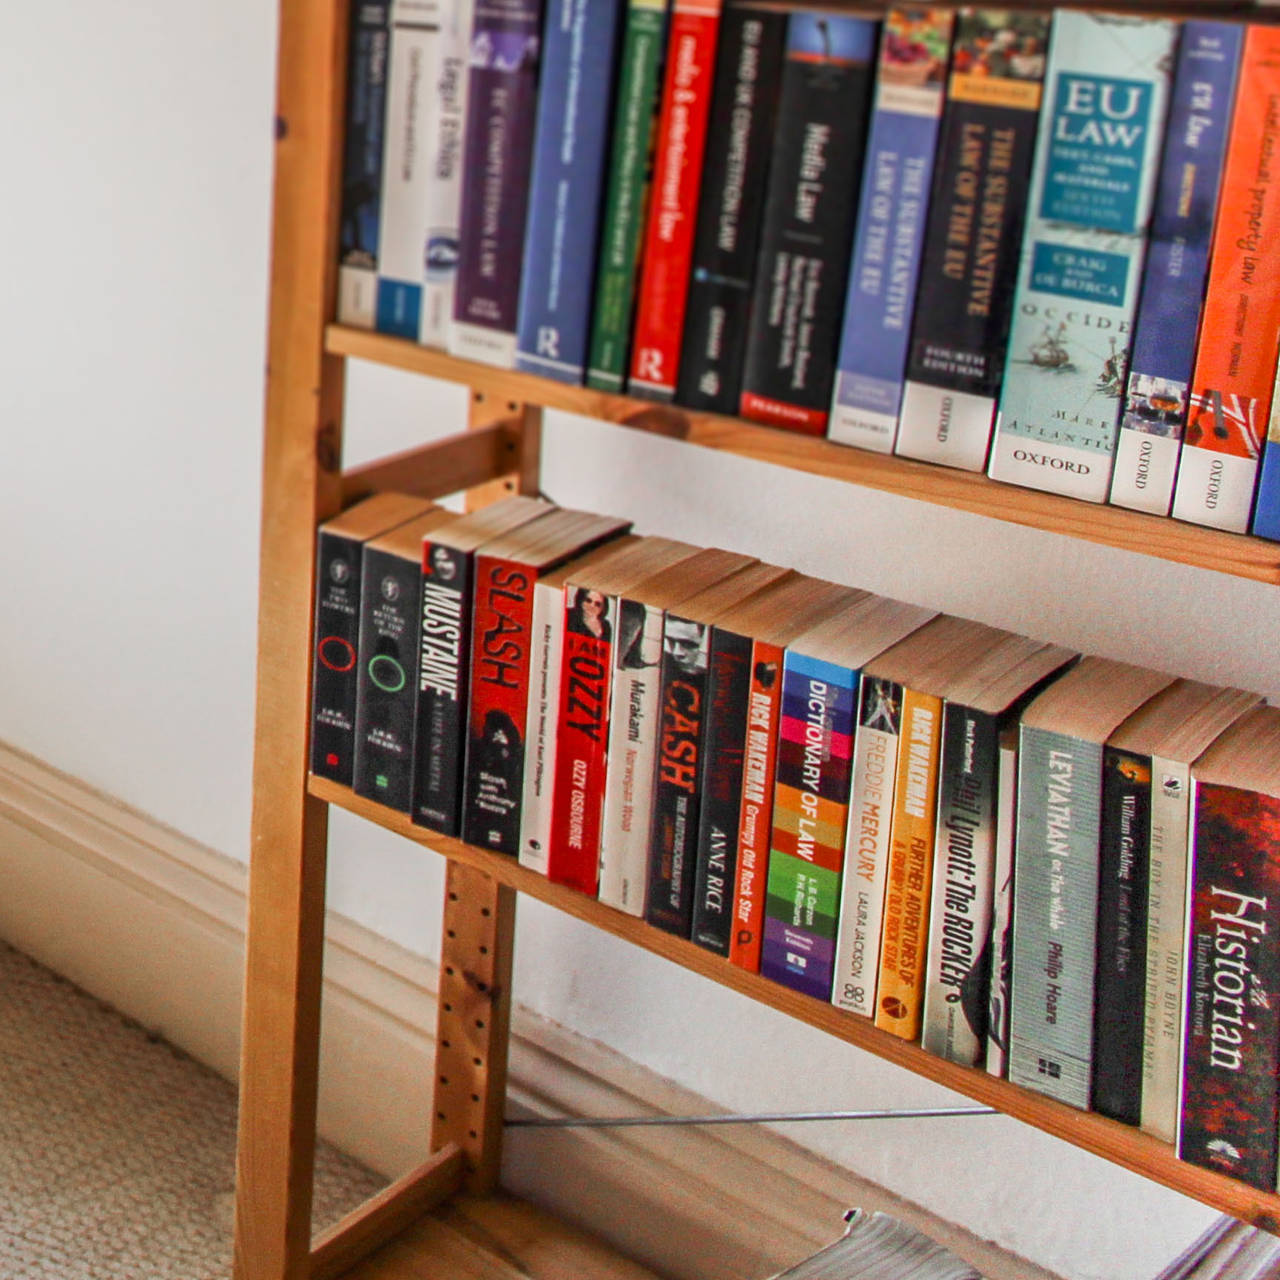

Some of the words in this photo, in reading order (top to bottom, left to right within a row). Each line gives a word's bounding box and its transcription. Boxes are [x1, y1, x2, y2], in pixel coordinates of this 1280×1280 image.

[742, 20, 763, 43] EU
[675, 36, 700, 86] media
[738, 45, 760, 81] AND
[439, 58, 462, 114] Legal
[673, 88, 697, 103] &
[735, 83, 755, 105] UK
[1064, 79, 1144, 120] EU
[436, 118, 461, 181] Ethics
[801, 123, 831, 179] Media
[960, 123, 984, 167] LAW
[992, 127, 1016, 172] THE
[1054, 115, 1143, 149] LAW
[1183, 114, 1211, 150] law
[482, 115, 506, 234] COMPETITION
[662, 105, 694, 208] entertainment
[720, 108, 753, 212] COMPETITION
[874, 151, 896, 192] LAW
[901, 156, 926, 192] THE
[795, 182, 823, 224] Law
[956, 172, 978, 199] OF
[1053, 172, 1132, 193] MATERIALS
[1175, 162, 1198, 219] DIRECTIONS
[657, 212, 684, 242] law
[870, 194, 890, 222] OF
[949, 201, 974, 243] THE
[1235, 187, 1268, 252] property
[719, 214, 741, 252] LAW
[864, 224, 887, 263] THE
[968, 175, 1012, 318] SUBSTANTIVE
[480, 238, 501, 277] LAW
[883, 196, 922, 330] SUBSTANTIVE
[944, 248, 968, 279] EU
[1052, 251, 1108, 272] CRAIG
[1167, 236, 1186, 279] FOSTER
[1239, 255, 1258, 286] law
[858, 266, 881, 295] EU
[922, 357, 985, 378] EDITION
[1051, 409, 1111, 430] MARE
[1012, 448, 1091, 476] OXFORD
[1134, 440, 1154, 490] OXFORD
[1204, 458, 1224, 510] OXFORD
[420, 582, 463, 702] MUSTAINE
[481, 566, 528, 690] SLASH
[565, 656, 605, 742] OZZY
[626, 679, 646, 745] Murakami
[748, 691, 773, 725] RICK
[660, 680, 700, 793] CASH
[801, 679, 827, 792] DICTIONARY
[912, 706, 933, 743] RICK
[965, 719, 977, 735] Mark
[571, 759, 587, 789] OZZY
[622, 748, 638, 802] Norwegian
[744, 729, 769, 804] WAKEMAN
[862, 733, 888, 801] FREDDIE
[905, 744, 930, 819] WAKEMAN
[675, 796, 688, 814] THE
[800, 791, 819, 818] OF
[950, 776, 985, 811] Phil
[1046, 749, 1074, 856] LEVIATHAN
[1118, 793, 1137, 835] William
[567, 790, 584, 850] OSBOURNE
[620, 804, 636, 833] Wood
[740, 804, 760, 847] Grumpy
[1151, 825, 1164, 850] THE
[670, 815, 686, 894] AUTOBIOGRAPHY
[708, 826, 728, 872] ANNE
[741, 849, 756, 868] Old
[795, 818, 816, 862] LAW
[856, 802, 882, 884] MERCURY
[893, 839, 908, 850] A
[944, 814, 981, 879] Lynott:
[1116, 835, 1134, 880] Golding
[739, 869, 754, 895] Rock
[890, 851, 907, 890] GRUMPY
[905, 836, 926, 890] FURTHER
[1150, 857, 1164, 885] BOY
[670, 896, 681, 909] OF
[705, 876, 724, 913] RICE
[889, 893, 904, 916] OLD
[947, 882, 977, 912] The
[1049, 874, 1066, 894] The
[1150, 892, 1163, 907] IN
[737, 896, 751, 922] Star
[855, 891, 871, 926] LAURA
[1148, 915, 1161, 943] THE
[886, 917, 901, 944] ROCK
[901, 893, 923, 968] ADVENTURES
[938, 912, 972, 989] ROCKER
[850, 928, 868, 979] JACKSON
[884, 945, 899, 971] STAR
[1043, 940, 1065, 981] Philip
[1164, 949, 1179, 984] JOHN
[1194, 933, 1211, 989] Elizabeth
[900, 969, 916, 988] OF
[1208, 884, 1269, 1071] Historian
[1043, 983, 1062, 1025] Hoare
[1162, 992, 1177, 1039] BOYNE
[1192, 991, 1208, 1036] Kostova
